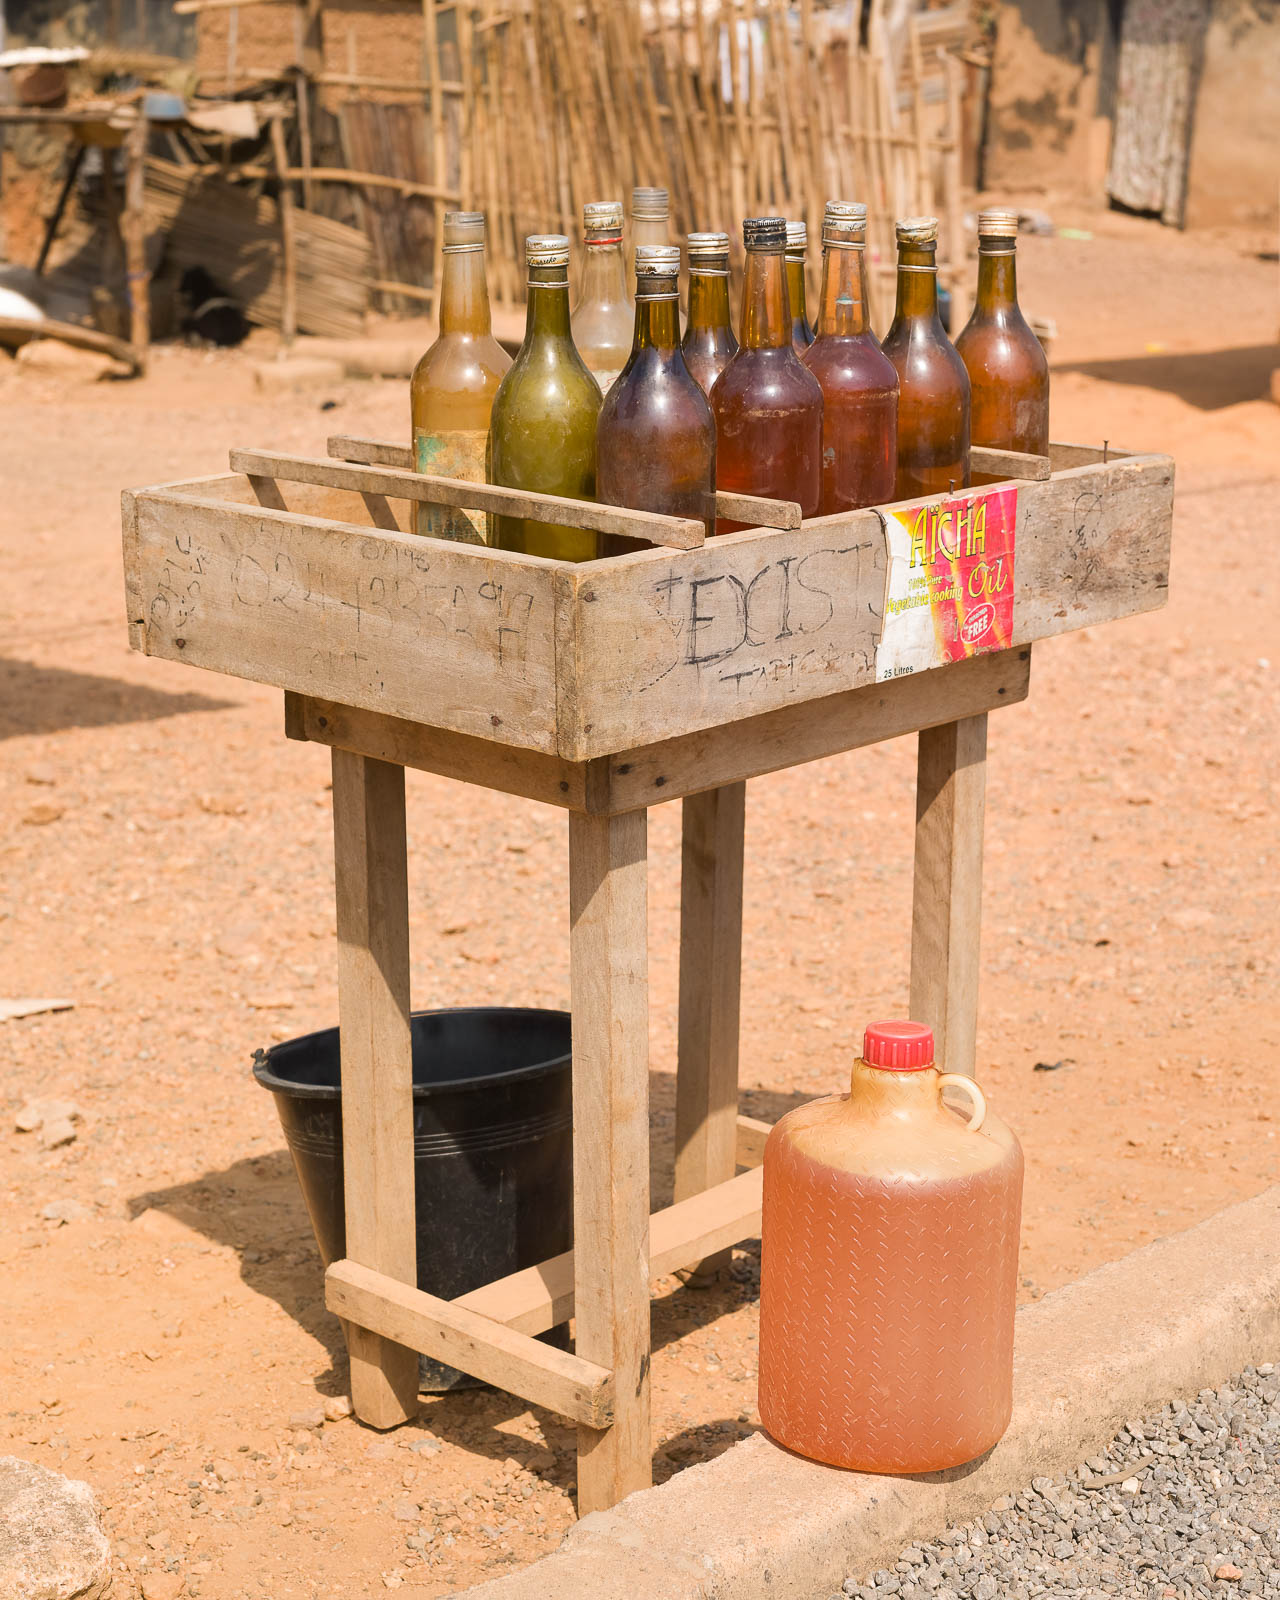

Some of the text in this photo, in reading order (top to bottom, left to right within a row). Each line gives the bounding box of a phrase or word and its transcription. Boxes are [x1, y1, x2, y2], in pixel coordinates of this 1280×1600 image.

[909, 501, 988, 569] AÏCHA
[968, 558, 1008, 598] Oil
[930, 586, 963, 604] cooking
[967, 614, 989, 641] FREE
[883, 665, 914, 679] 25 Litres
